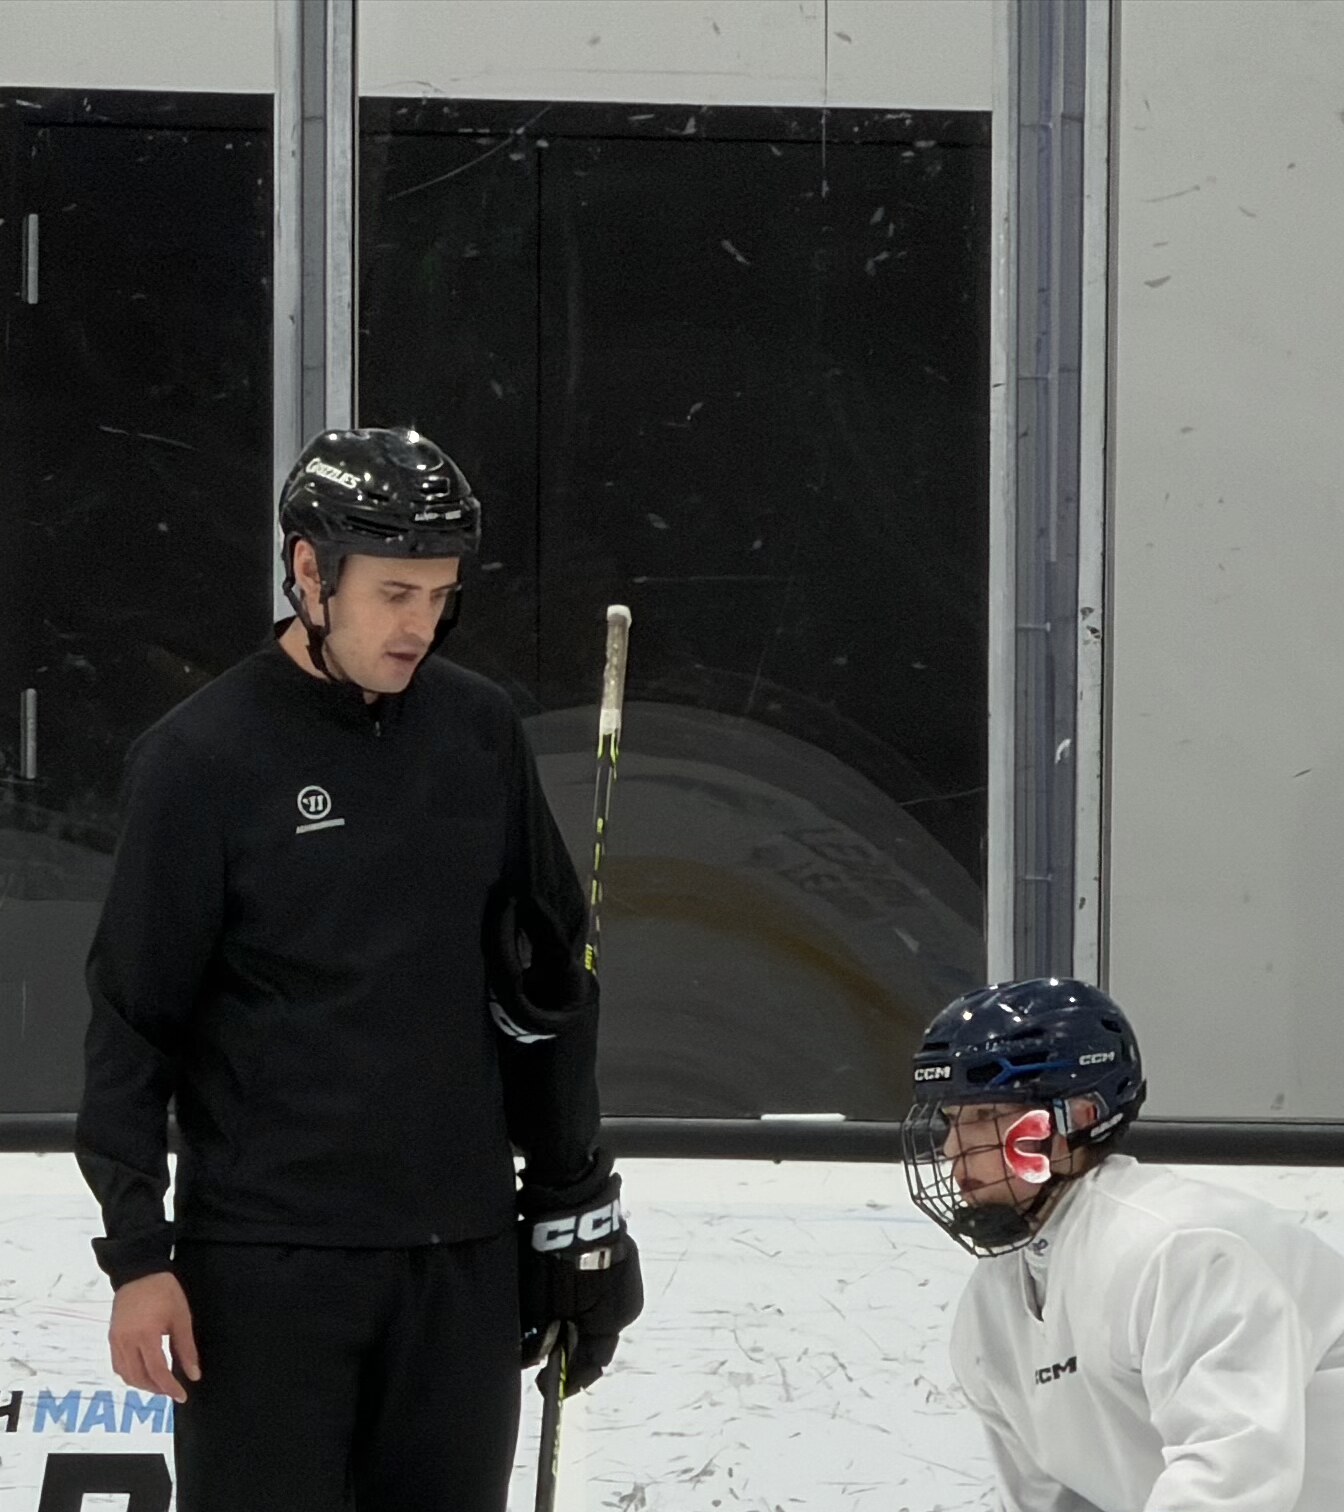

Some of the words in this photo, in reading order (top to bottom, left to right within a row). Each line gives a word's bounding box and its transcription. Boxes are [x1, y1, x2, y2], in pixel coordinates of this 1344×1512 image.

[1079, 1050, 1116, 1066] CCM
[913, 1065, 951, 1082] CCM
[1034, 1355, 1078, 1385] CM
[32, 1390, 175, 1434] MAM
